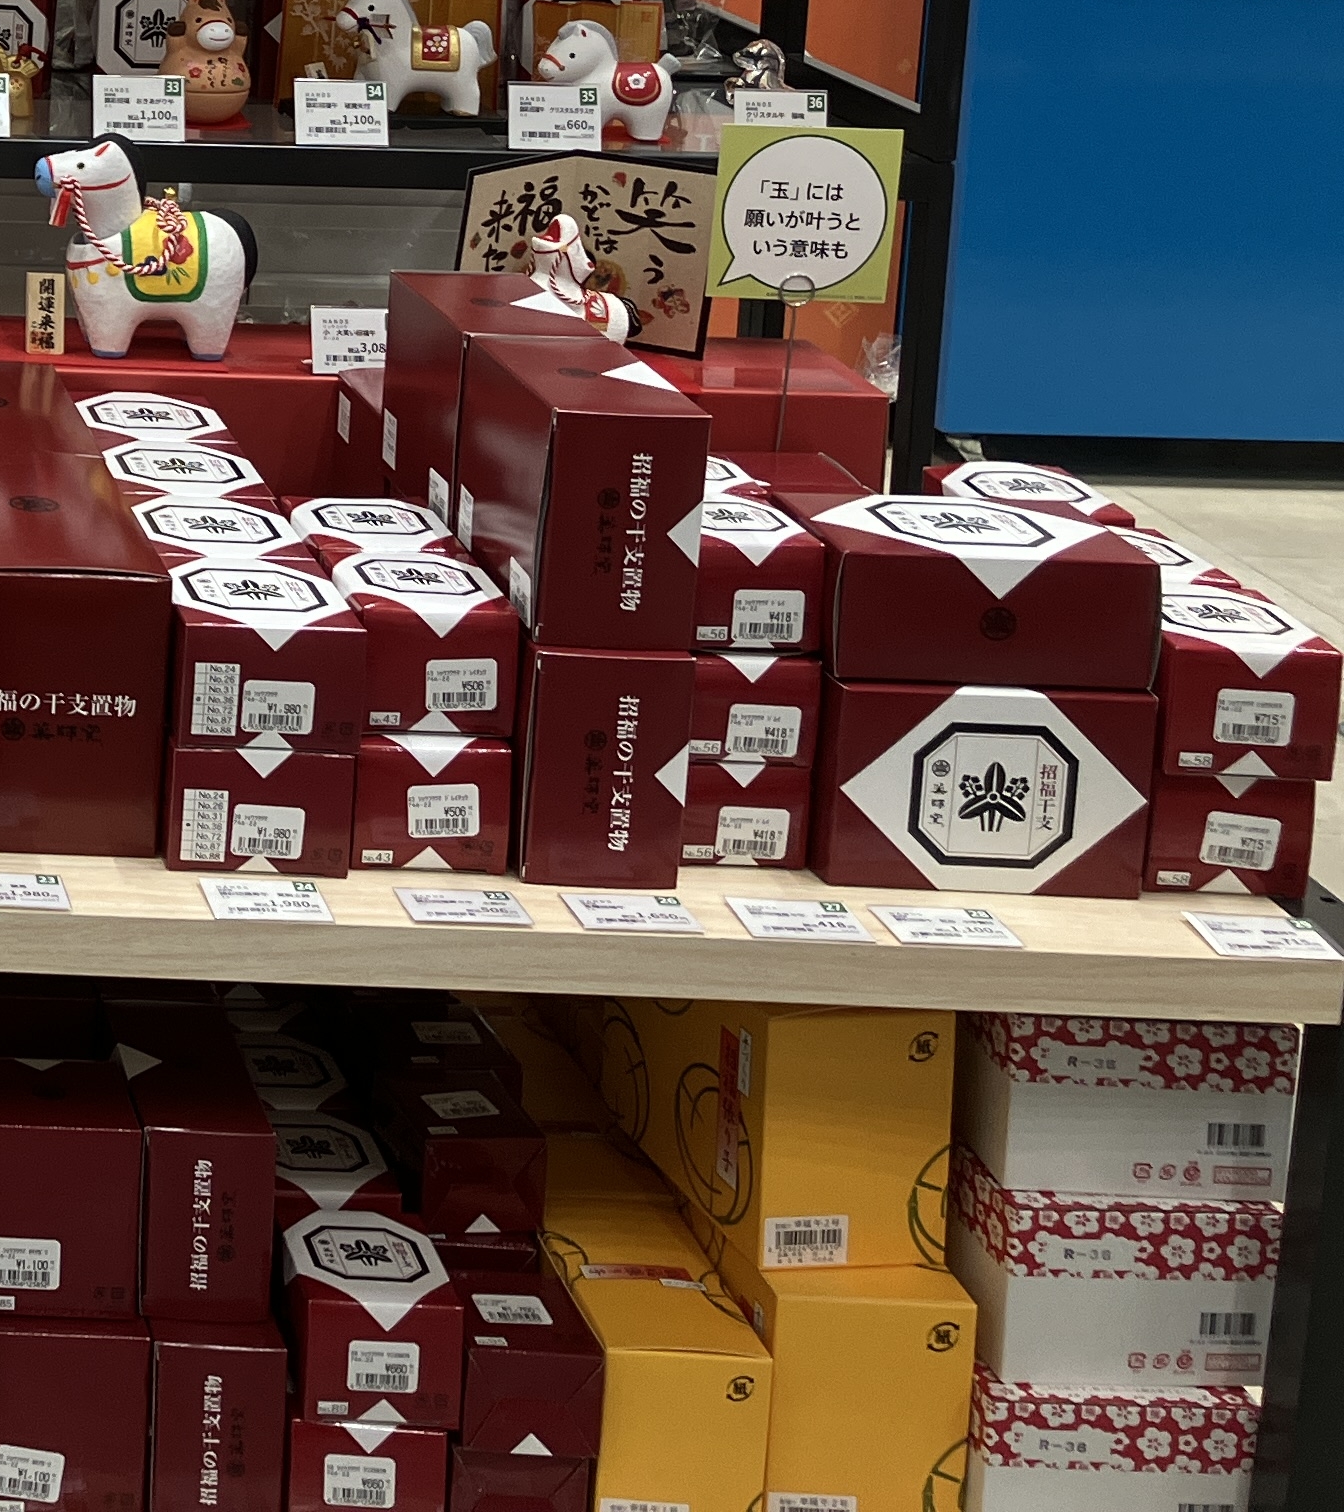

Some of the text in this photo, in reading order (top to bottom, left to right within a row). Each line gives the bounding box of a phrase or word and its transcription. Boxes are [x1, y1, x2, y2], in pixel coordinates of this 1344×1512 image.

[581, 89, 595, 101] 35
[808, 96, 824, 110] 36
[760, 180, 844, 201] 「玉」には
[744, 209, 861, 231] 願いが叶うと
[752, 239, 848, 260] いう意味も
[38, 276, 54, 352] 開運来福
[607, 695, 641, 852] 招福の干支置物
[1038, 762, 1058, 833] 招福干支
[190, 1159, 212, 1290] 招福の干支置物
